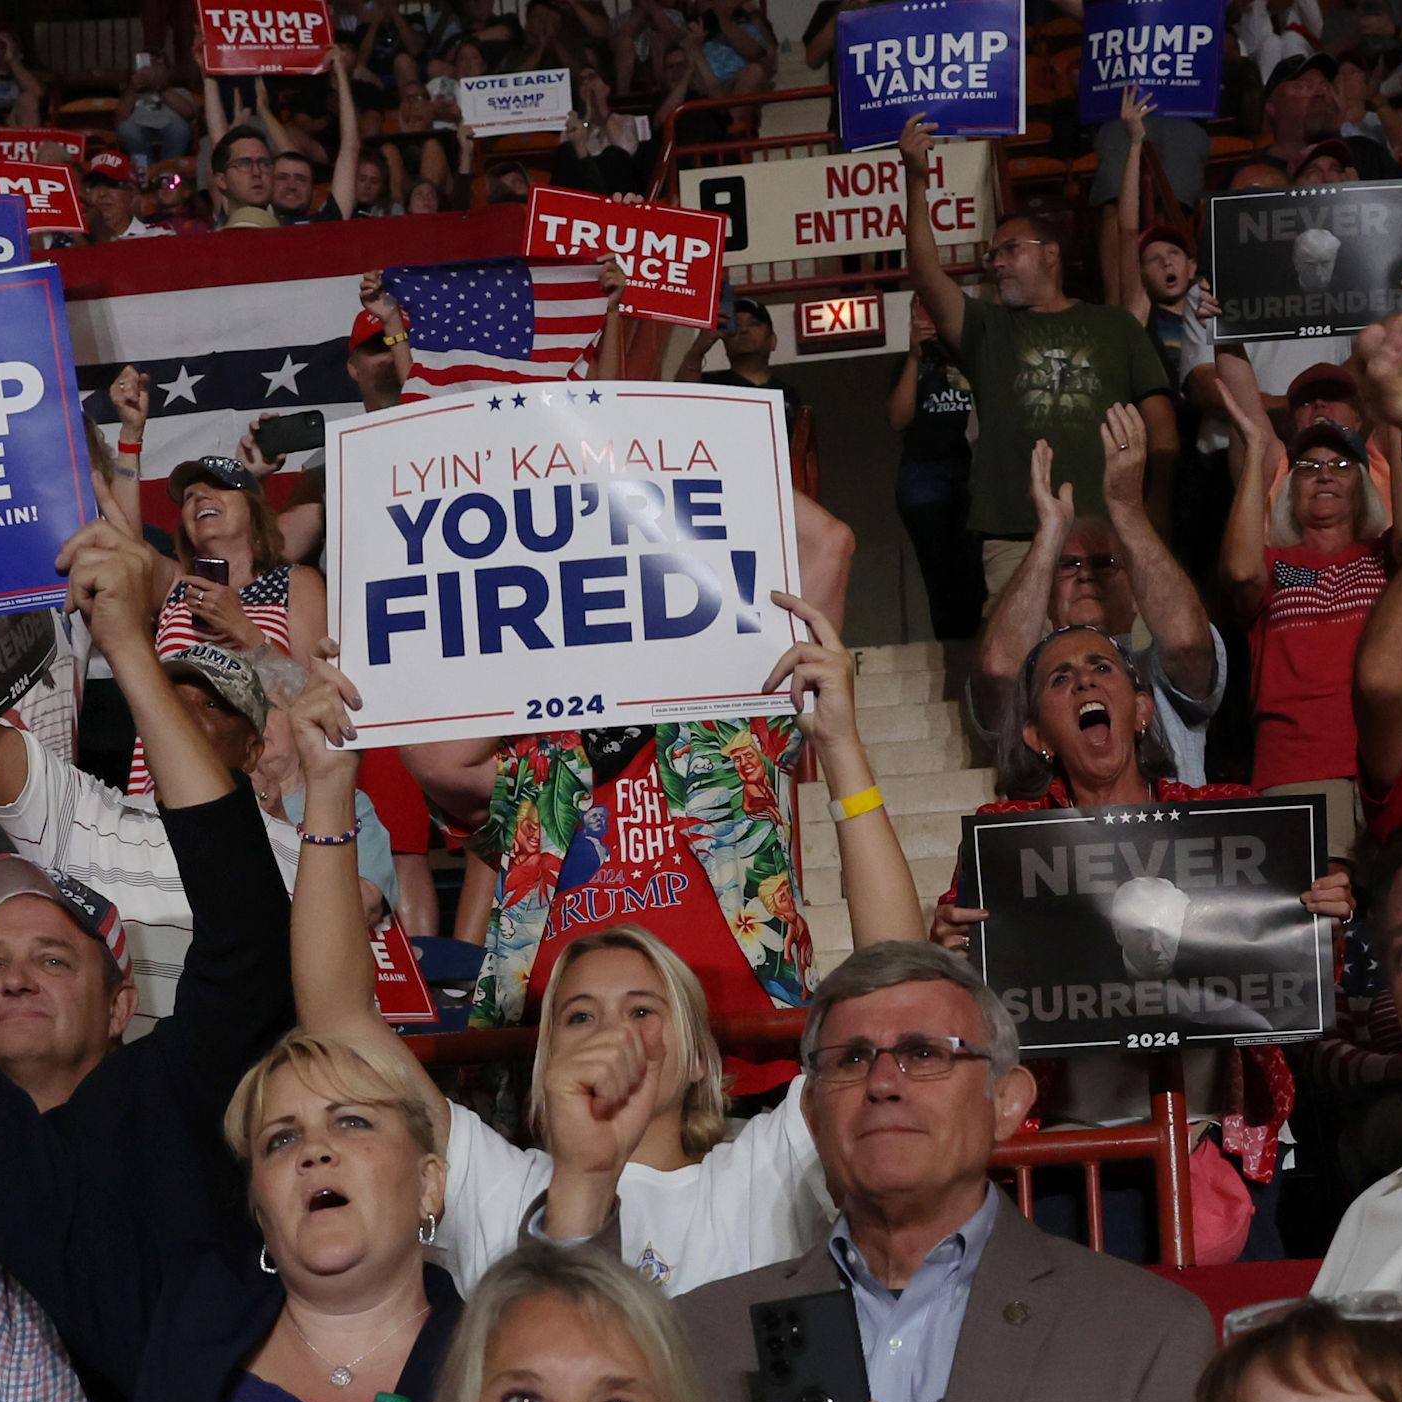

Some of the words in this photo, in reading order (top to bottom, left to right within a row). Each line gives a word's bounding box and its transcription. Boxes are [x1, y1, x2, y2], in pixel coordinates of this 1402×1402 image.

[204, 9, 323, 30] TRUMP
[220, 27, 314, 45] VANCE
[1088, 24, 1214, 60] TRUMP
[848, 31, 1008, 75] TRUMP
[1097, 53, 1195, 82] VANCE
[465, 78, 508, 91] VOTE
[514, 73, 565, 87] EARLY
[865, 64, 988, 98] VANCE
[488, 93, 544, 106] SWAMP
[860, 101, 883, 112] MAKE
[884, 94, 924, 106] AMERICA
[927, 92, 959, 102] GREAT
[962, 91, 997, 100] AGAIN!
[796, 198, 976, 245] ENTRACE
[1238, 202, 1389, 244] NEVER
[538, 214, 711, 263] TRUMP
[555, 244, 689, 285] NCE
[659, 283, 696, 296] AGAIN!
[618, 304, 634, 313] 24
[805, 299, 878, 334] EXIT
[1299, 325, 1331, 338] 2024
[512, 438, 718, 482] KAMALA
[365, 550, 762, 666] FIRED!
[9, 676, 31, 701] 2024
[526, 694, 606, 720] 2024
[1020, 835, 1268, 898] NEVER
[61, 888, 97, 916] 024
[1002, 971, 1307, 1024] SURRENDER
[1126, 1032, 1180, 1049] 2024
